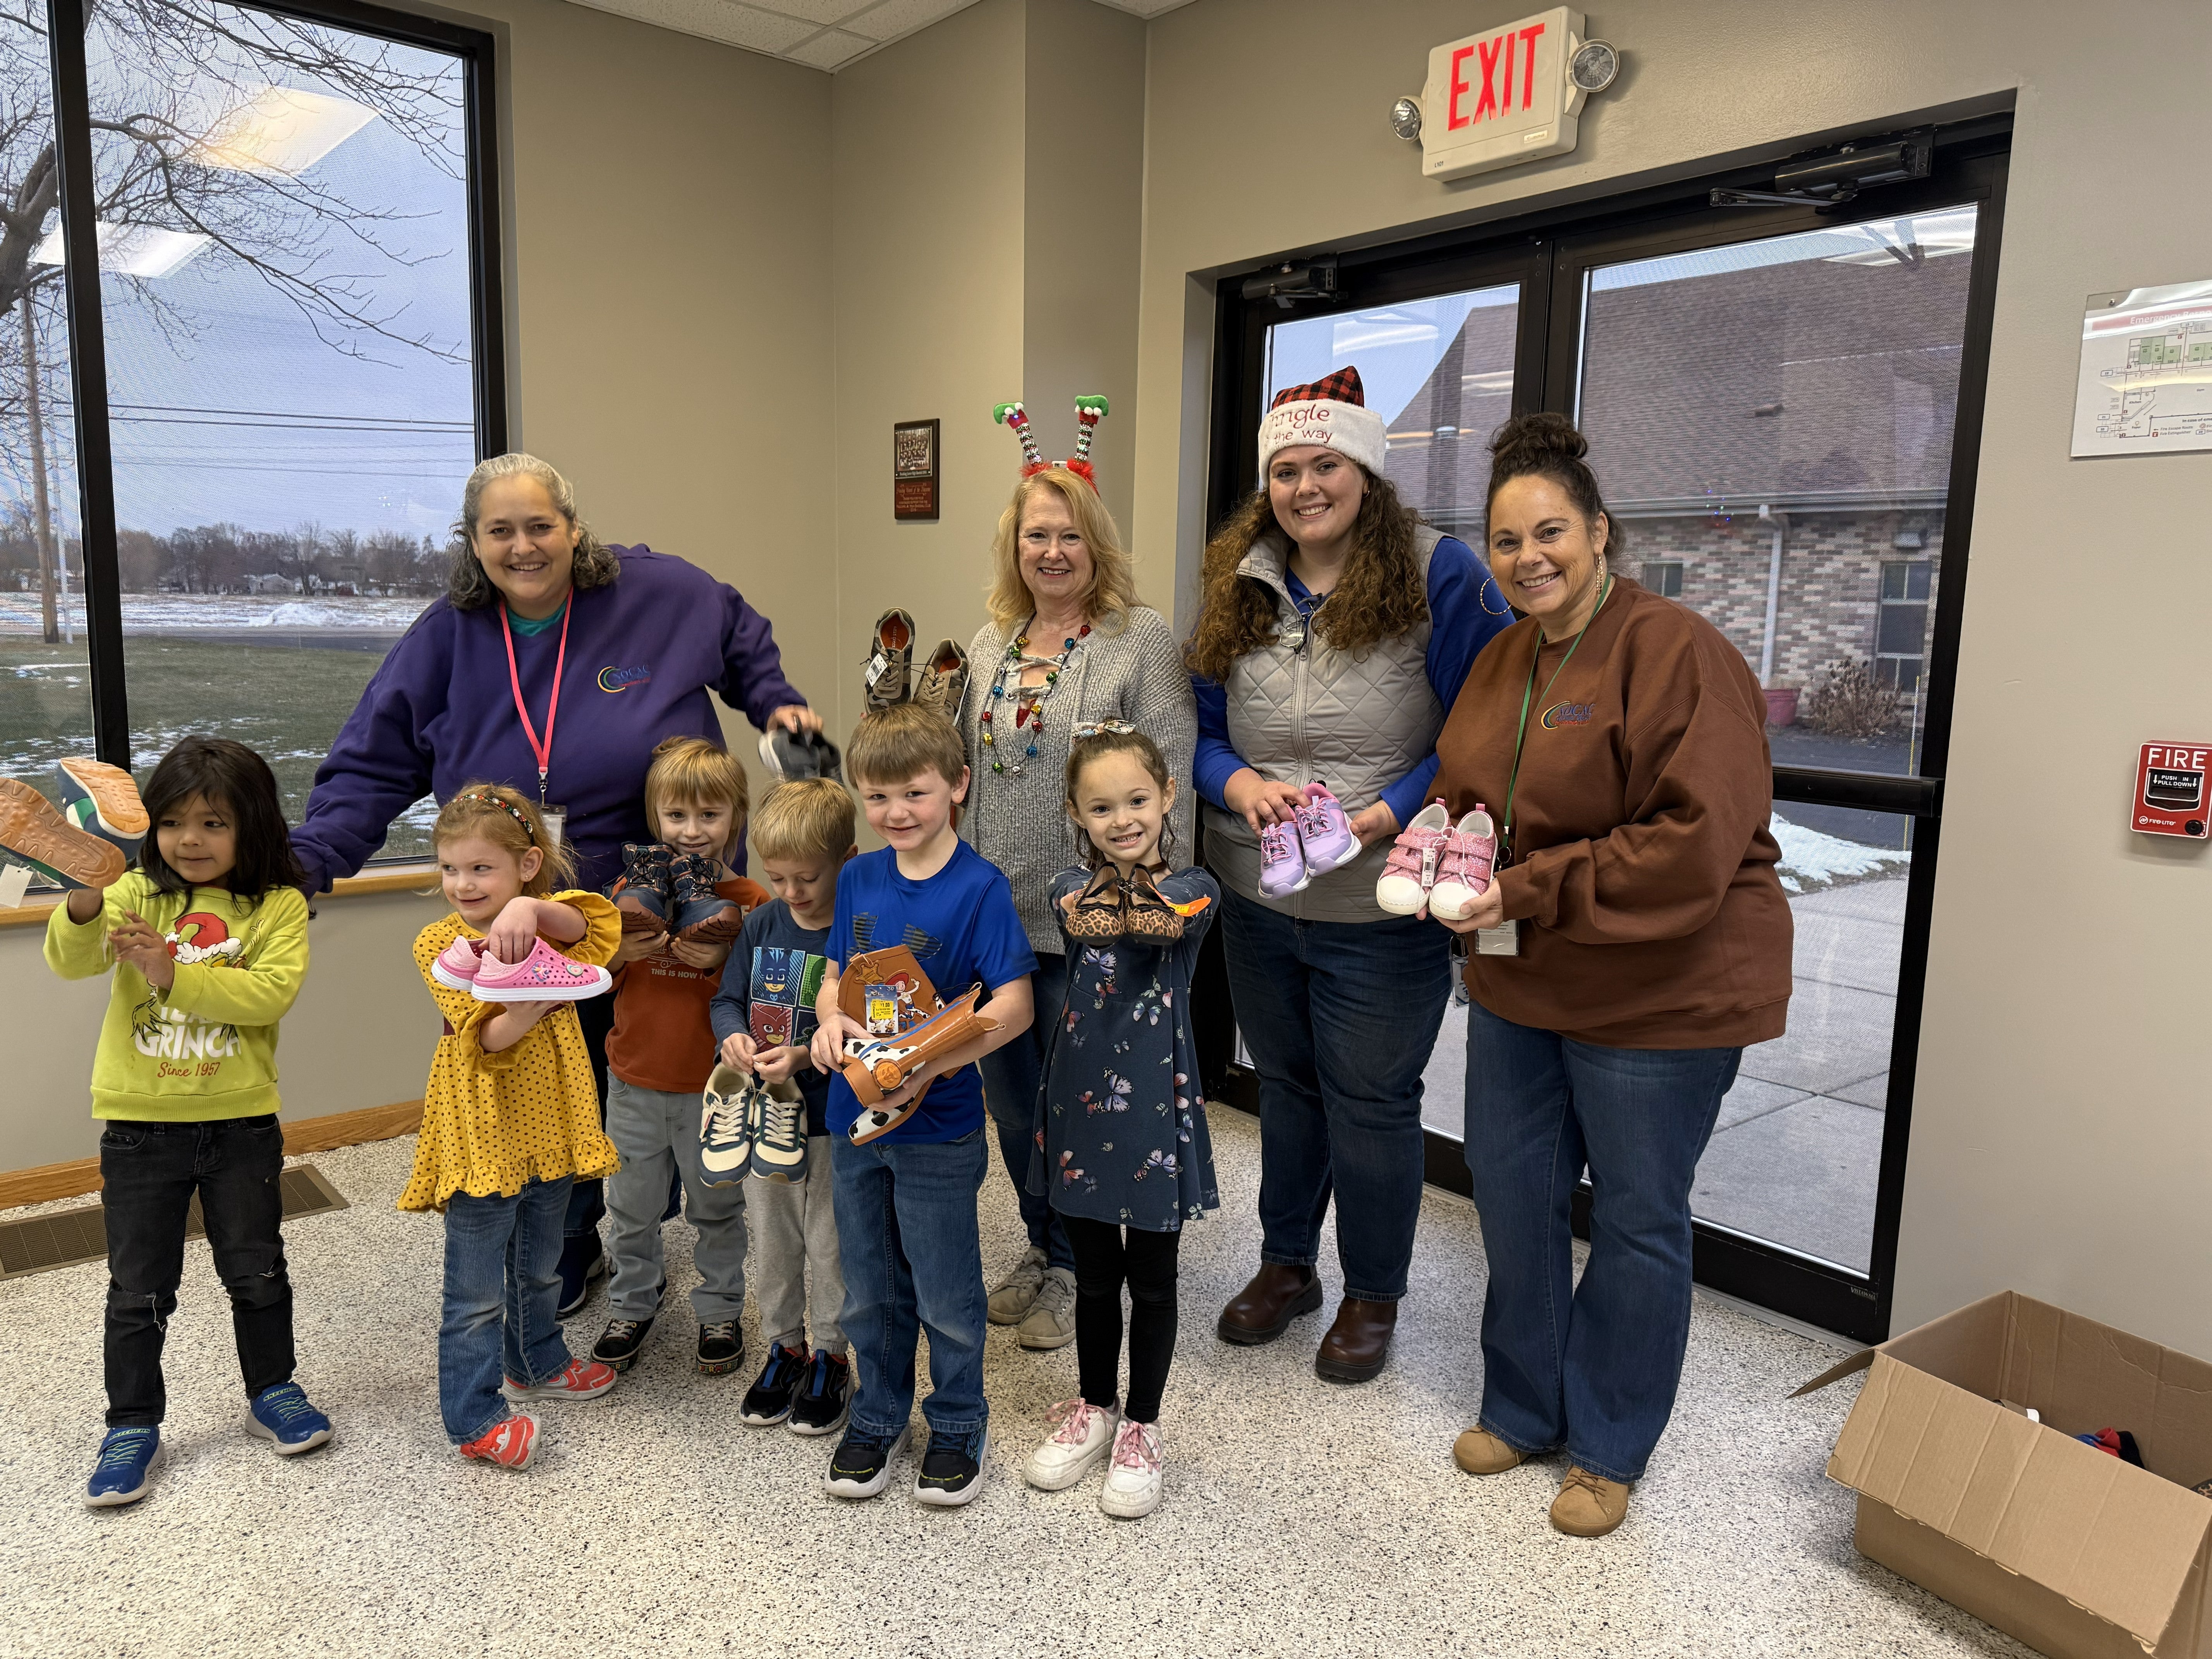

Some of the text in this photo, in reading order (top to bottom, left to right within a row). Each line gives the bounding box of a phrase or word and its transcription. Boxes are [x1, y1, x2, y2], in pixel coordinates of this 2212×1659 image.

[1448, 22, 1545, 131] EXIT
[1302, 430, 1333, 443] way
[2148, 748, 2207, 769] FIRE
[135, 1025, 241, 1060] GRINCH
[157, 1062, 221, 1078] Since 1957
